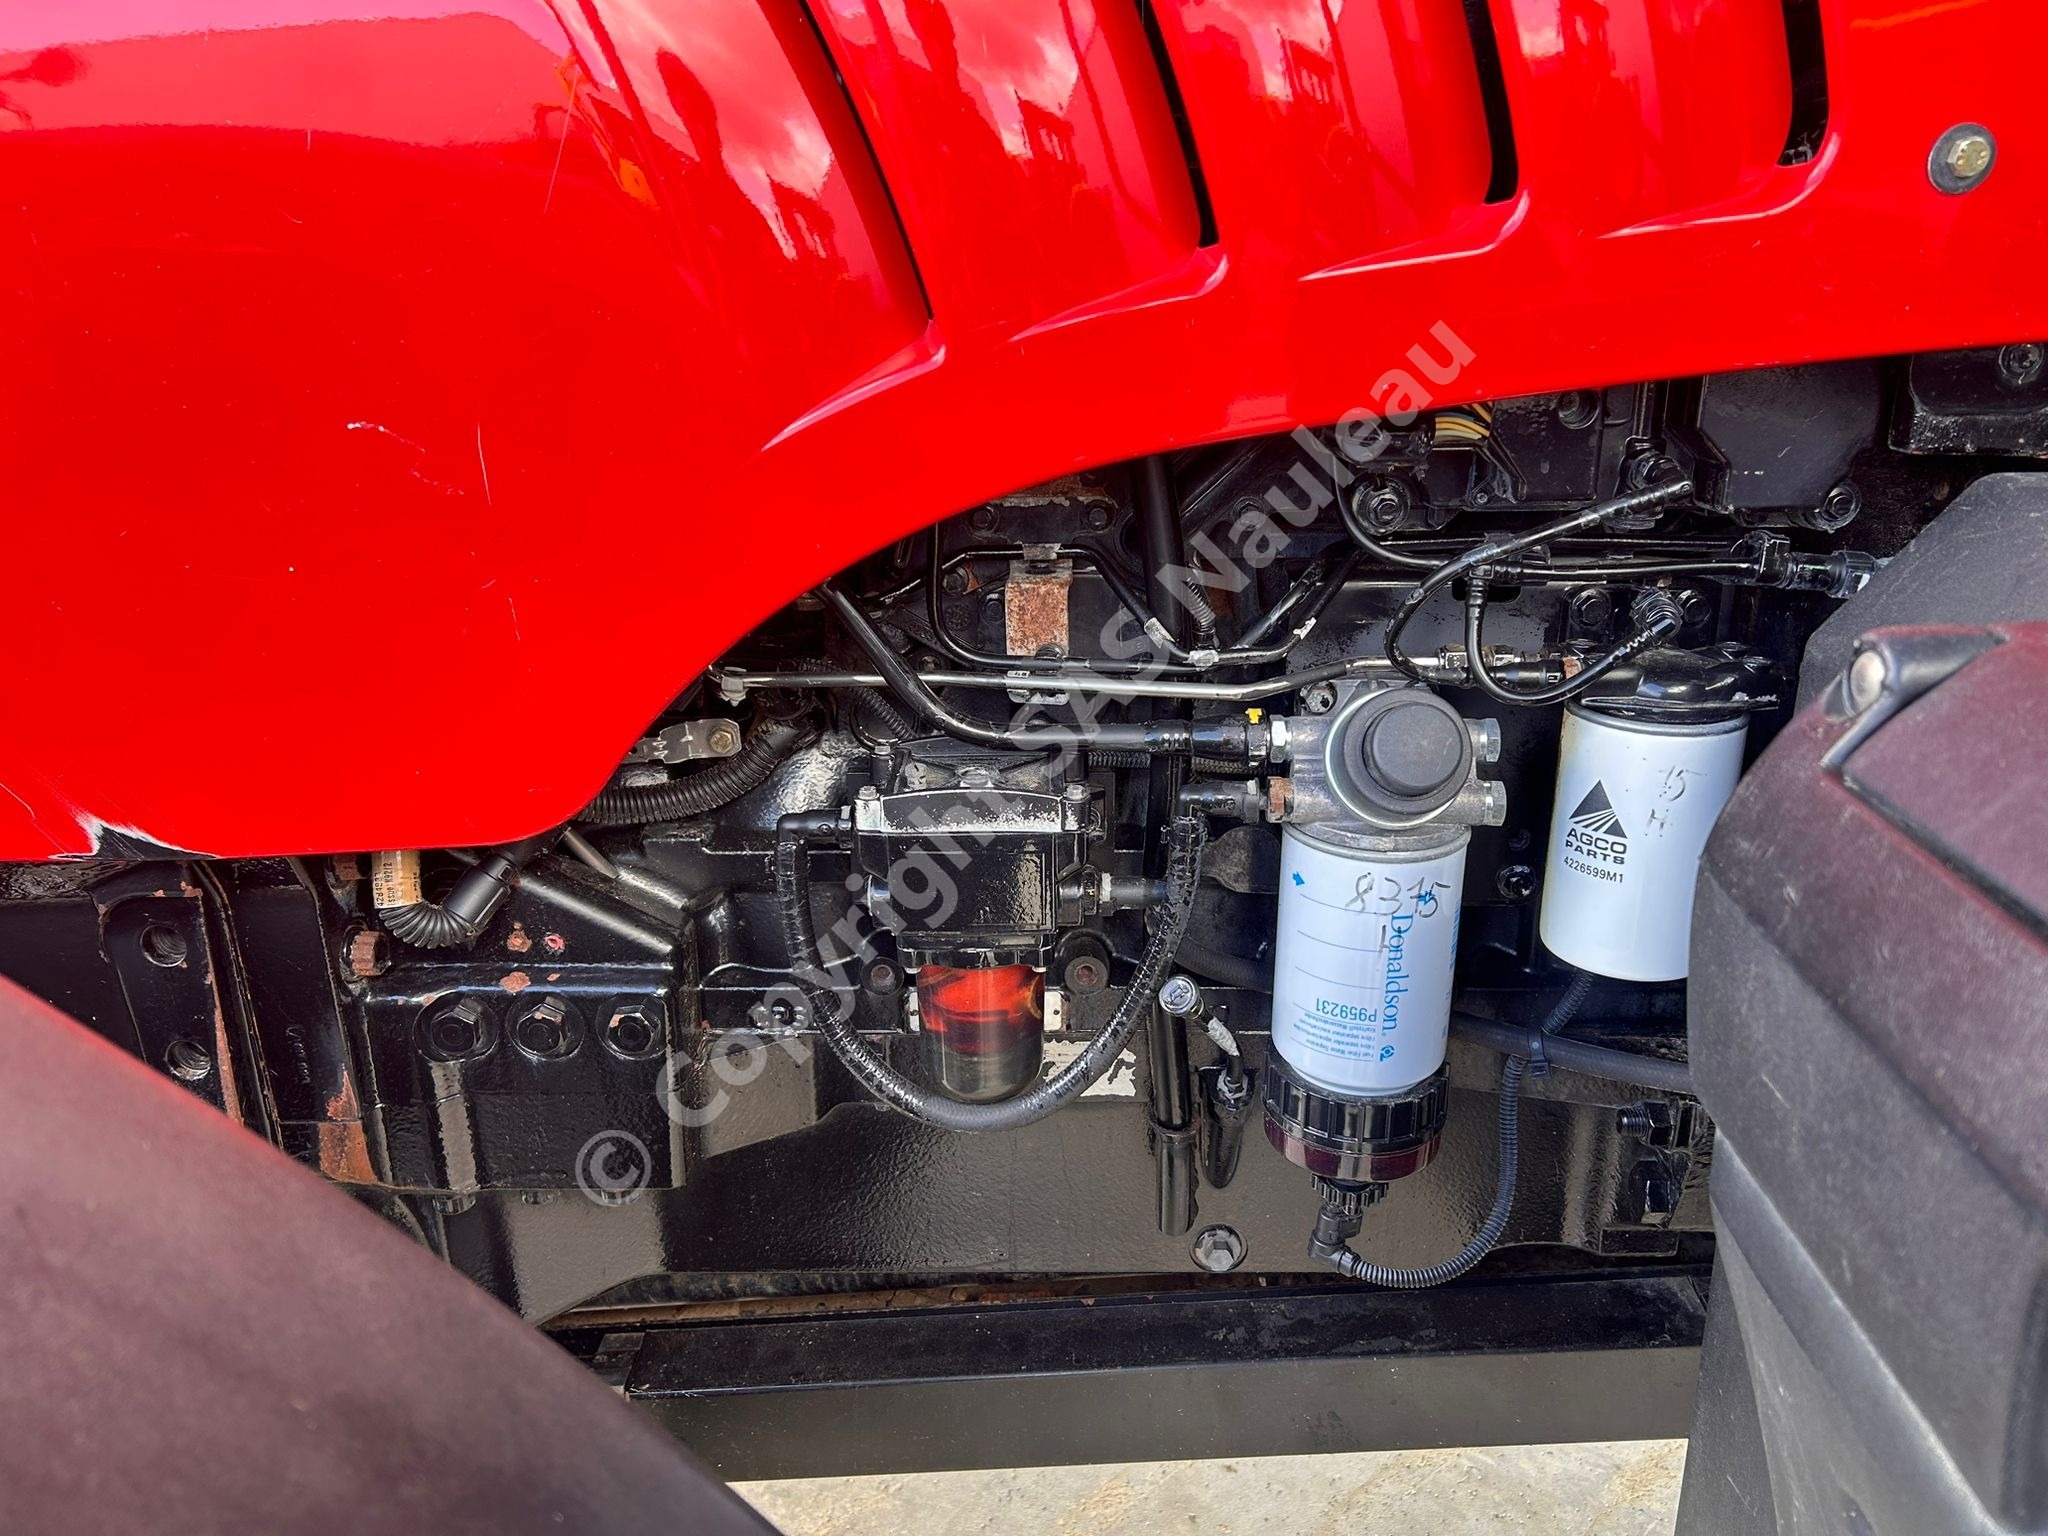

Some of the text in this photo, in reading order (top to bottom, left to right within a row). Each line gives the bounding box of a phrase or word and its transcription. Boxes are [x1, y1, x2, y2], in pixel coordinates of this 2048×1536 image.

[1565, 839, 1625, 865] PARTS
[1567, 827, 1627, 854] AGCO
[1564, 856, 1623, 883] 4226599M1
[1382, 913, 1413, 1031] Donaldson
[1315, 997, 1377, 1023] P959231
